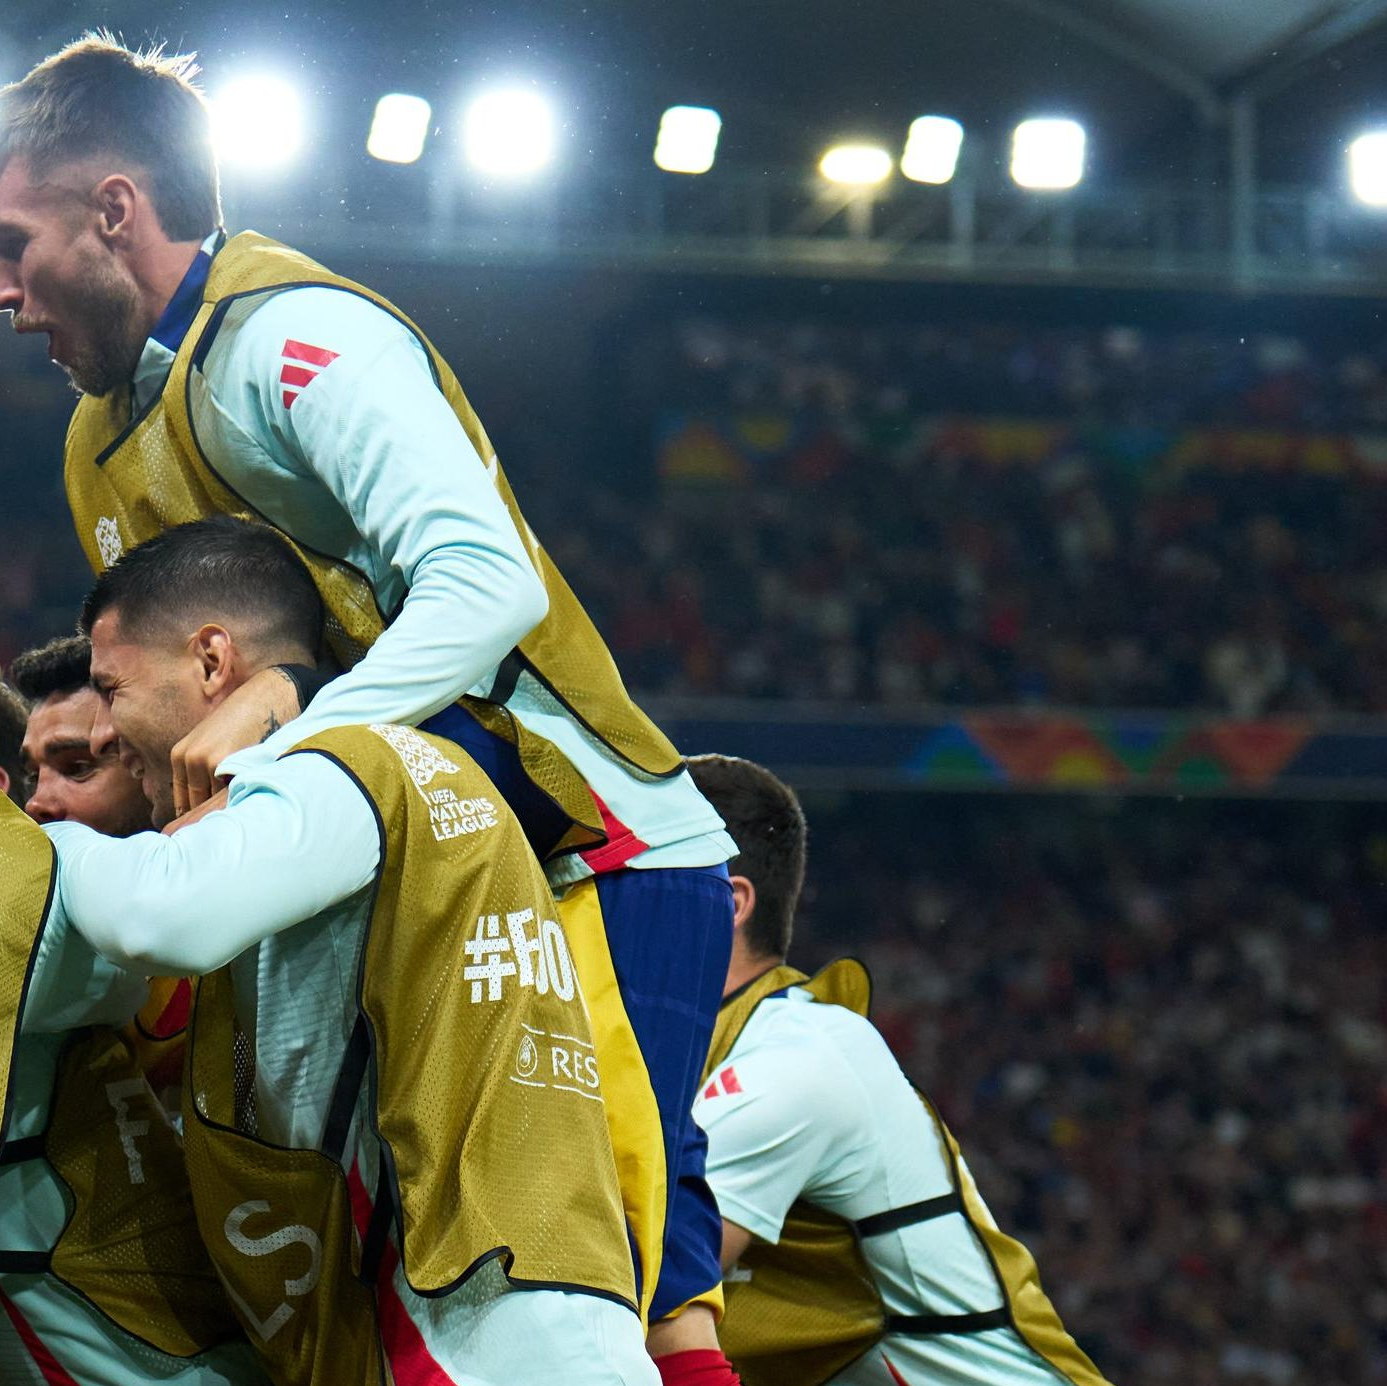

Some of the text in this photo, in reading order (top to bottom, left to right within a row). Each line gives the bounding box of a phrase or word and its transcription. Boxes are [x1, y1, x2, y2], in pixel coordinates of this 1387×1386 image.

[428, 788, 459, 806] UEFA
[429, 797, 495, 825] NATIONS
[431, 812, 499, 842] LEAGUE
